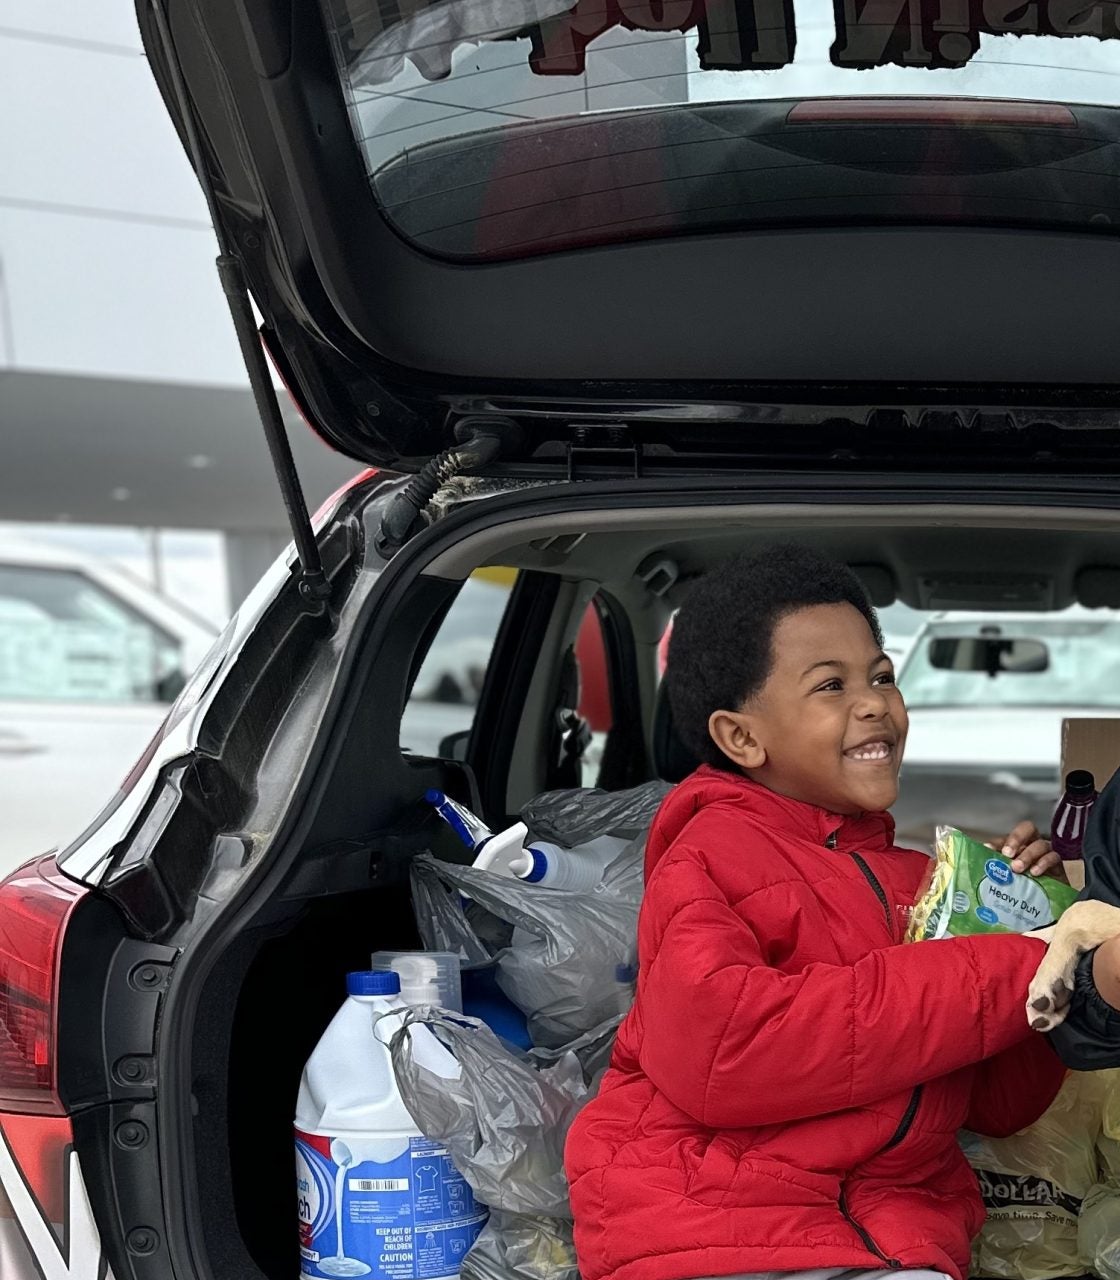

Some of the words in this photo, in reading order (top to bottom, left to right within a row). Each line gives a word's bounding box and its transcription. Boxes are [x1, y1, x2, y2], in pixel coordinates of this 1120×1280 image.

[988, 885, 1019, 907] Heavy
[1020, 899, 1041, 918] Duty
[376, 1227, 391, 1236] KEEP
[391, 1227, 404, 1235] OUT
[404, 1226, 412, 1234] OF
[384, 1235, 404, 1243] REACH
[404, 1234, 412, 1242] OF
[383, 1242, 413, 1251] CHILDREN
[379, 1252, 413, 1263] CAUTION
